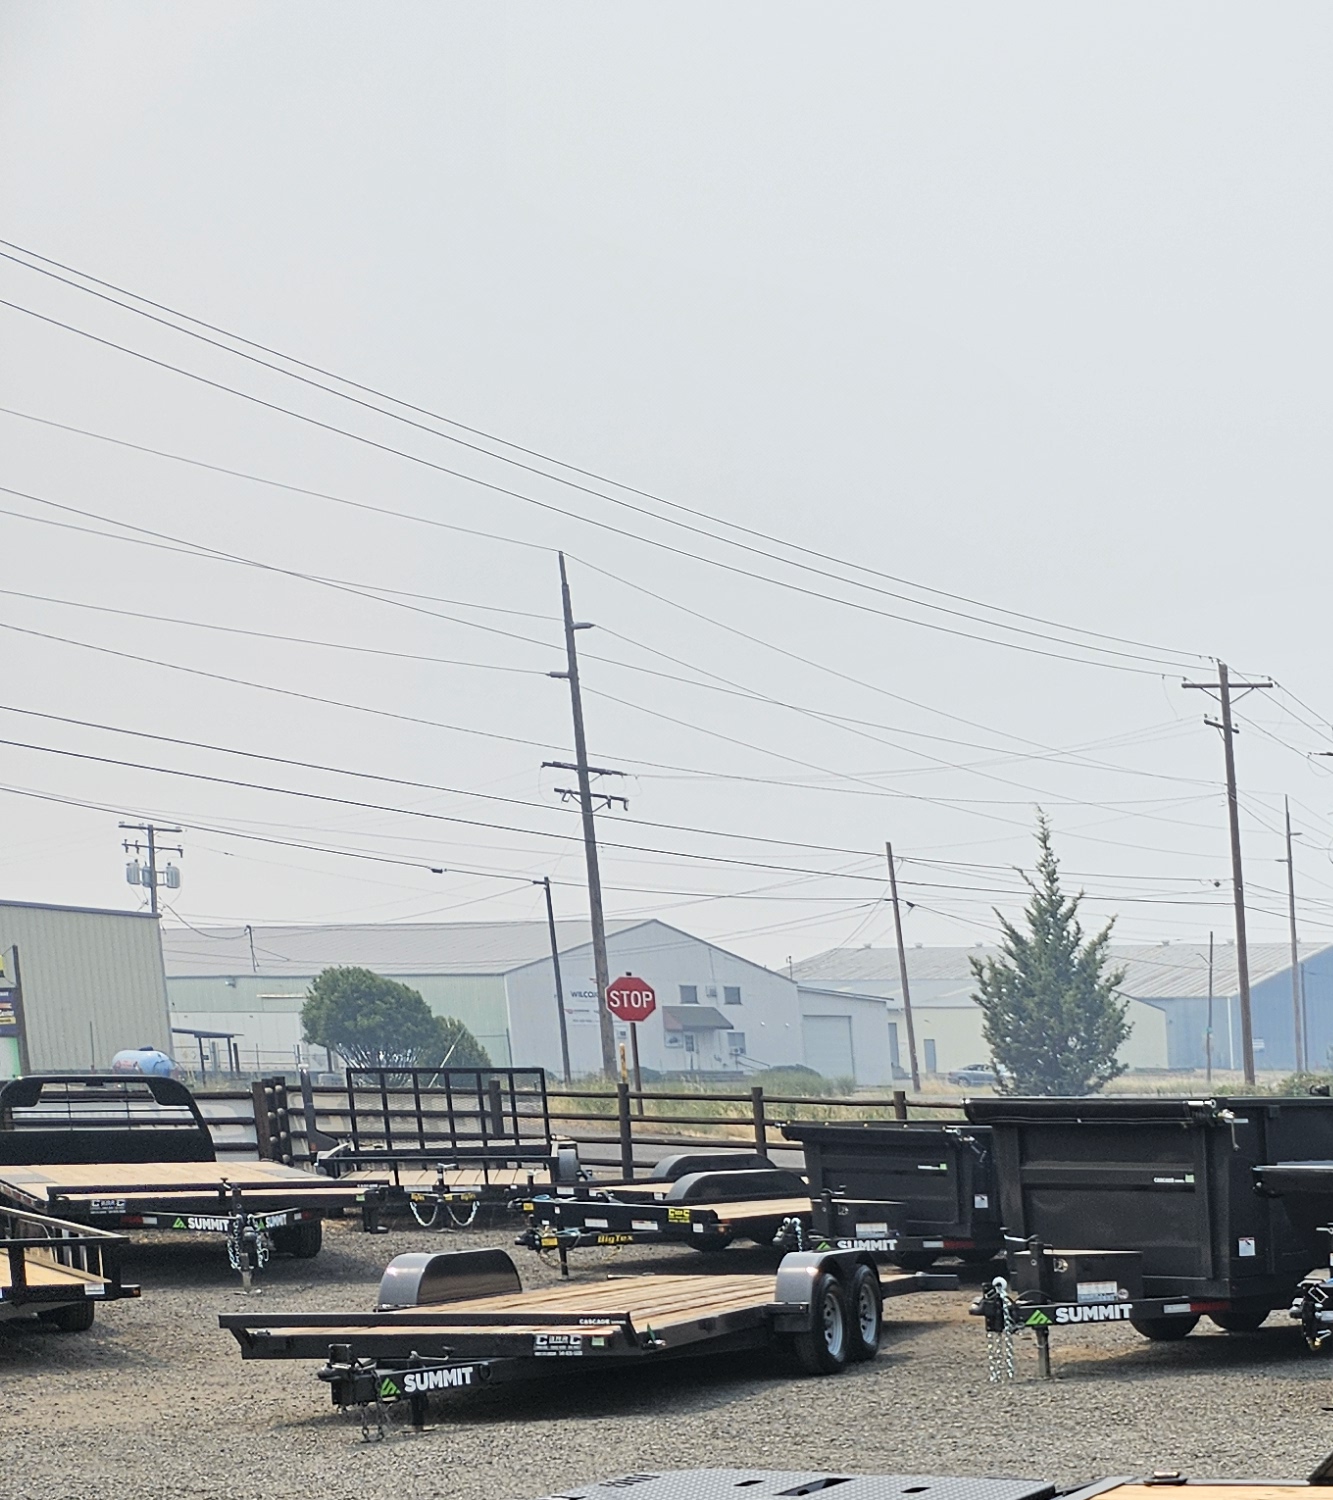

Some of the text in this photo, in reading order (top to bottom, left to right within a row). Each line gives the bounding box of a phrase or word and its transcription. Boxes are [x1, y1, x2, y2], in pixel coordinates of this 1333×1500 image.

[609, 990, 653, 1008] STOP
[188, 1217, 229, 1231] SUMMIT
[837, 1239, 898, 1251] SUMMIT
[1055, 1303, 1133, 1323] SUMMIT
[403, 1366, 474, 1393] SUMMIT
